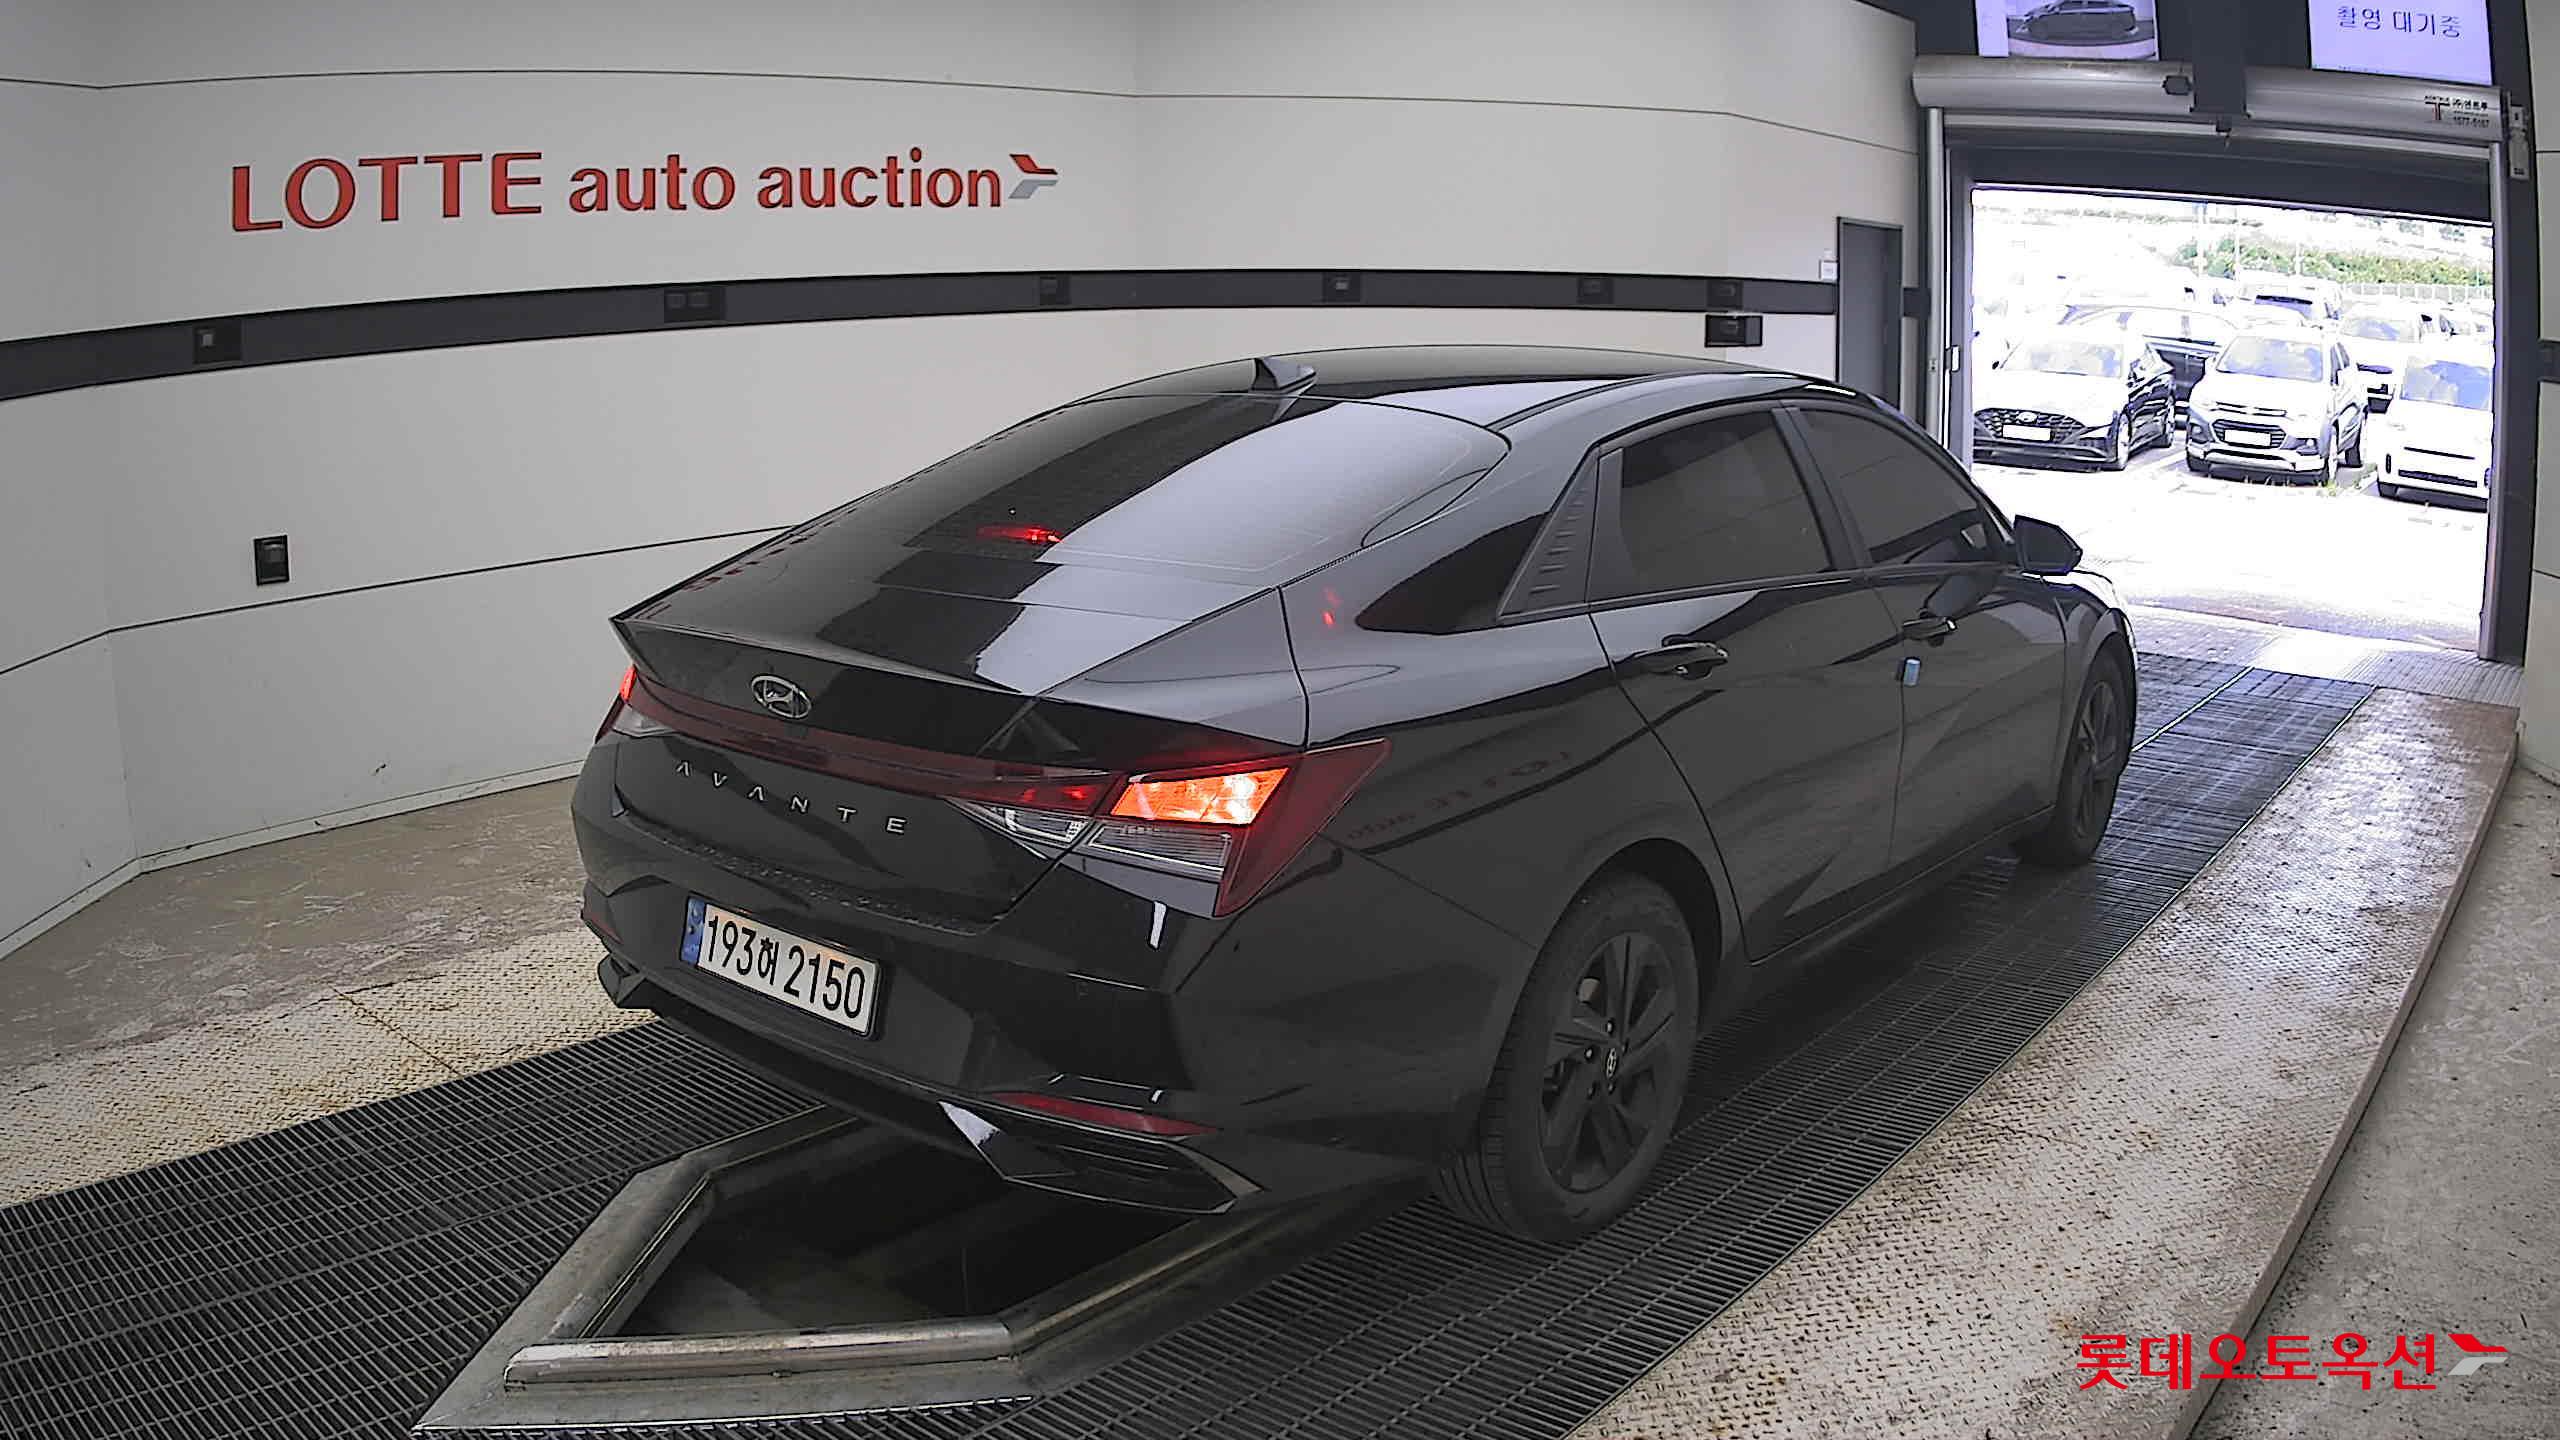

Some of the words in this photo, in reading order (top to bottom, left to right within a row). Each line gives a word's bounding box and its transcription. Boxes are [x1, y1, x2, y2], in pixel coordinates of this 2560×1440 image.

[2338, 6, 2382, 31] 촬영
[2393, 11, 2461, 38] 대기중
[231, 151, 543, 231] LOTTE
[568, 152, 738, 212] auto
[757, 146, 1002, 210] auction
[676, 761, 907, 833] AVANTE
[708, 915, 780, 985] 193허
[783, 945, 866, 1019] 2150
